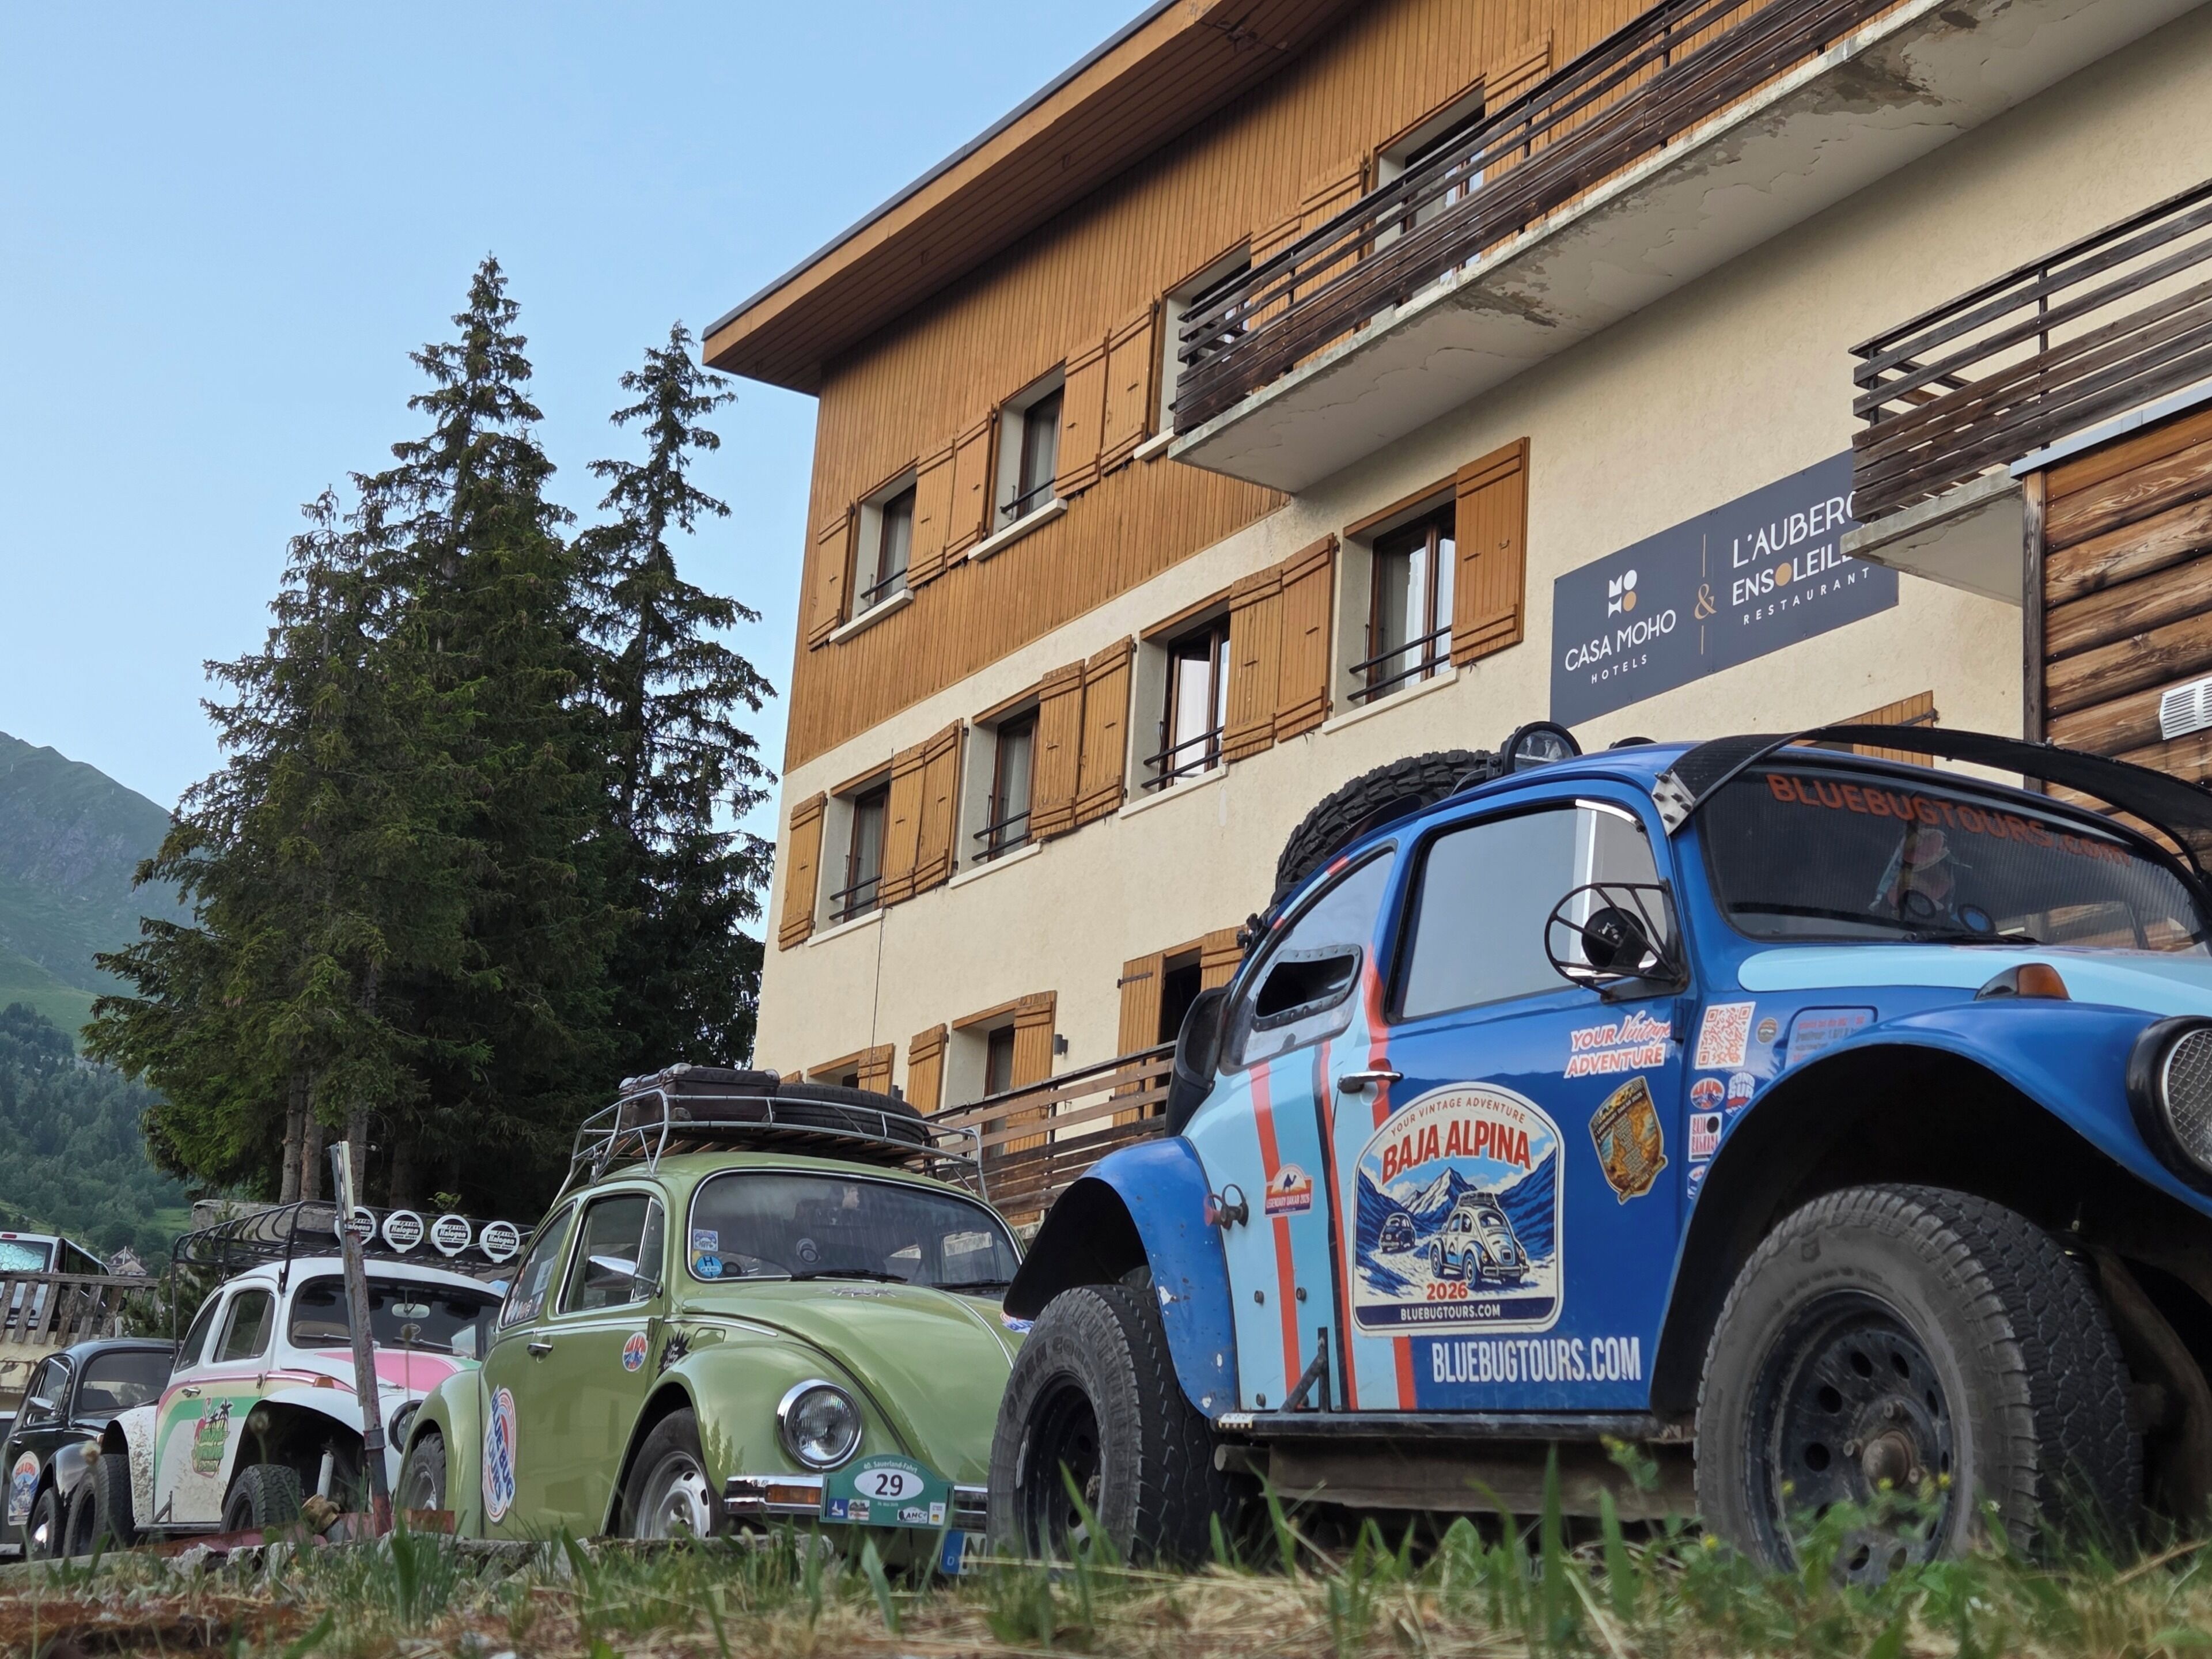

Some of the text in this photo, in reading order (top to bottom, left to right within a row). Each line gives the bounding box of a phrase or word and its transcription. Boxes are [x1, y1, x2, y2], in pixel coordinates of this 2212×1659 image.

[1694, 583, 1717, 620] &
[1744, 567, 1869, 625] RESTAURANT
[1565, 609, 1676, 671] CASA MOHO
[1591, 654, 1647, 684] HOTELS
[1574, 1012, 1669, 1049] YOUR Vintage
[1567, 1047, 1663, 1075] ADVENTURE
[1391, 1097, 1525, 1137] YOUR VINTAGE ADVENTURE
[1382, 1120, 1531, 1185] BAJA ALPINA
[391, 1225, 419, 1234] Halogen
[440, 1229, 466, 1238] Halogen
[488, 1235, 514, 1245] Halogen
[1426, 1282, 1468, 1301] 2026
[1401, 1304, 1500, 1320] BLUEBUGTOURS.COM
[1432, 1336, 1641, 1383] BLUEBUGTOURS.COM
[491, 1392, 514, 1500] BLUE BUG
[487, 1433, 502, 1502] TOURS
[875, 1474, 903, 1497] 29
[947, 1556, 955, 1566] D
